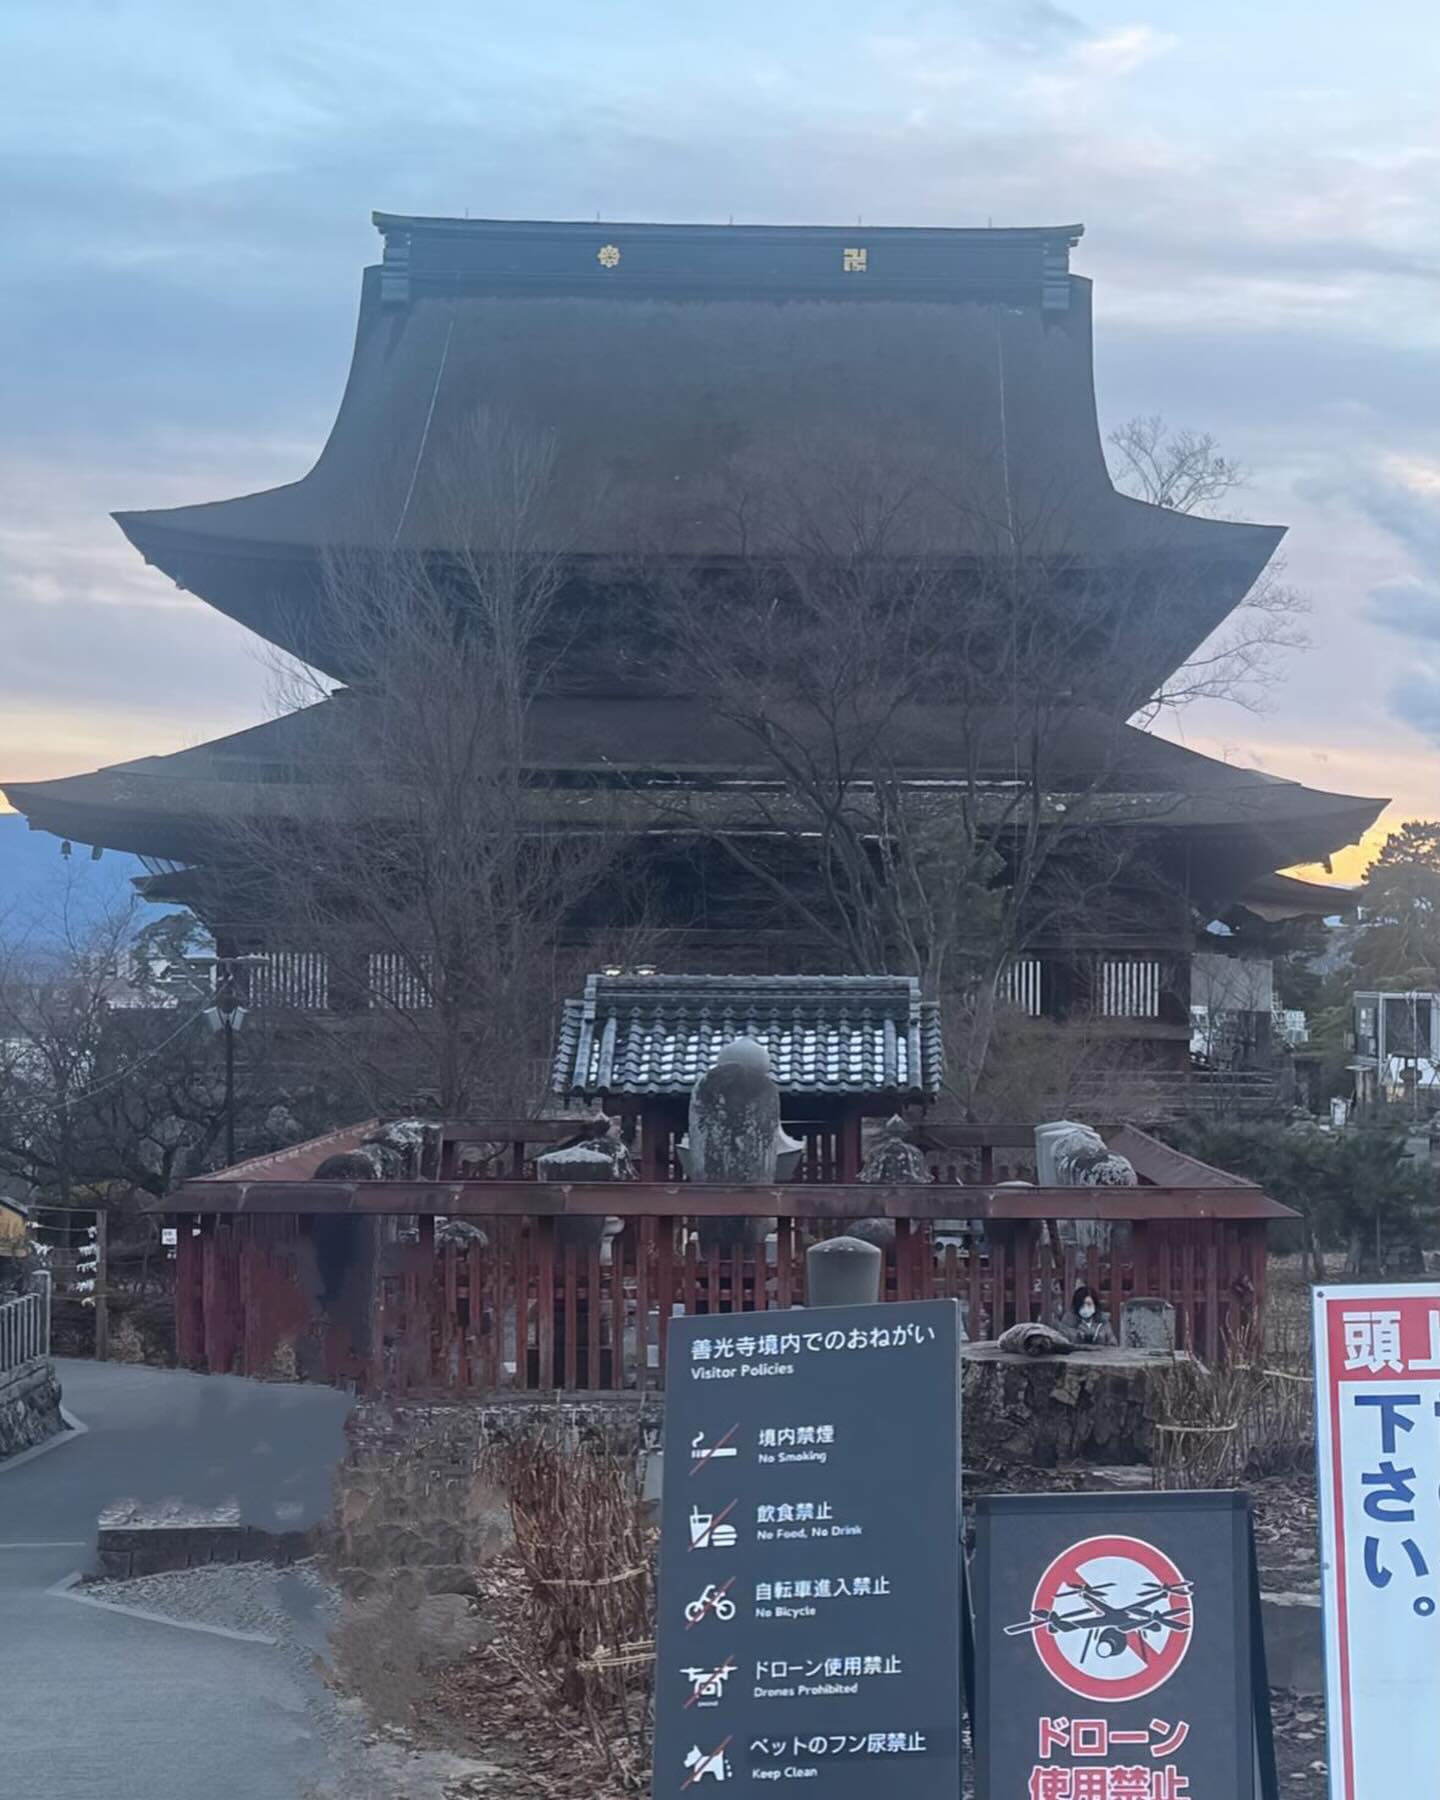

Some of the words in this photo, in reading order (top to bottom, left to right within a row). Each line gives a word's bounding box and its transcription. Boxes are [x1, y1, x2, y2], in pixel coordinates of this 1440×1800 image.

[691, 1325, 935, 1360] 善光寺境内でのおねがい
[691, 1365, 737, 1380] Visitor
[741, 1362, 795, 1377] Policies
[758, 1424, 835, 1447] 境内禁煙
[758, 1453, 775, 1464] No
[778, 1450, 827, 1464] Smoking
[757, 1501, 833, 1523] 飲食禁止
[1354, 1394, 1436, 1617] 下さい。
[757, 1530, 774, 1541] No
[776, 1528, 808, 1539] Food,
[811, 1527, 829, 1537] No
[831, 1525, 862, 1537] Drink
[755, 1576, 891, 1601] 自転車進入禁止
[755, 1607, 772, 1618] No
[774, 1605, 816, 1619] Bicycle
[756, 1654, 902, 1680] ドローン使用禁止
[753, 1687, 795, 1698] Drones
[798, 1683, 858, 1697] Prohibited
[1039, 1716, 1190, 1758] ドローン
[752, 1768, 781, 1780] Keep
[784, 1766, 818, 1778] Clean
[1028, 1765, 1192, 1800] 使用禁止
